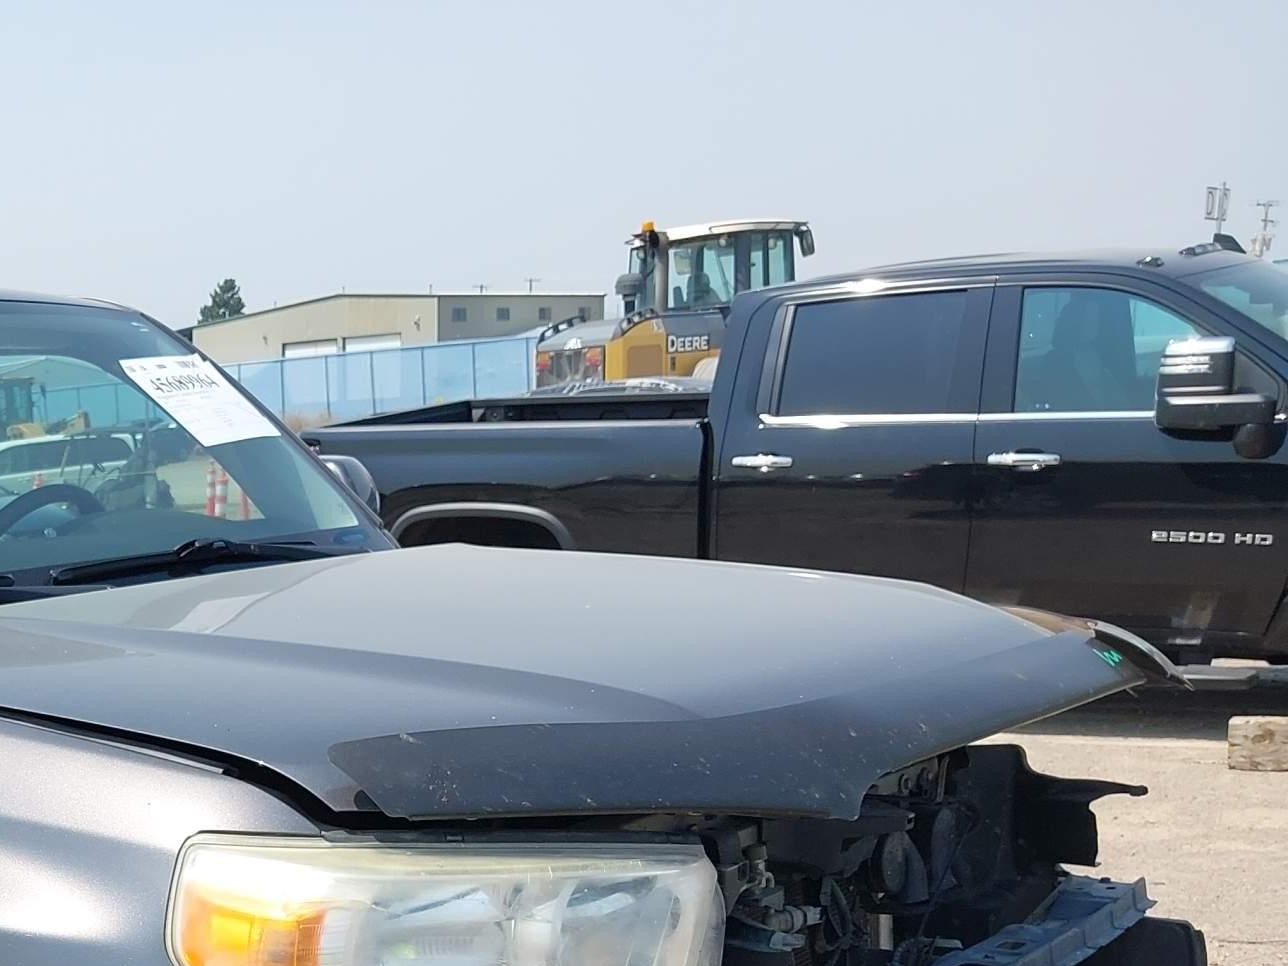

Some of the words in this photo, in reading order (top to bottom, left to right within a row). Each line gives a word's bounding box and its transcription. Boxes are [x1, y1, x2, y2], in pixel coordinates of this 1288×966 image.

[667, 335, 709, 353] DEERE
[149, 373, 220, 393] 45689964
[1151, 530, 1226, 544] 2500
[1234, 532, 1274, 545] HD
